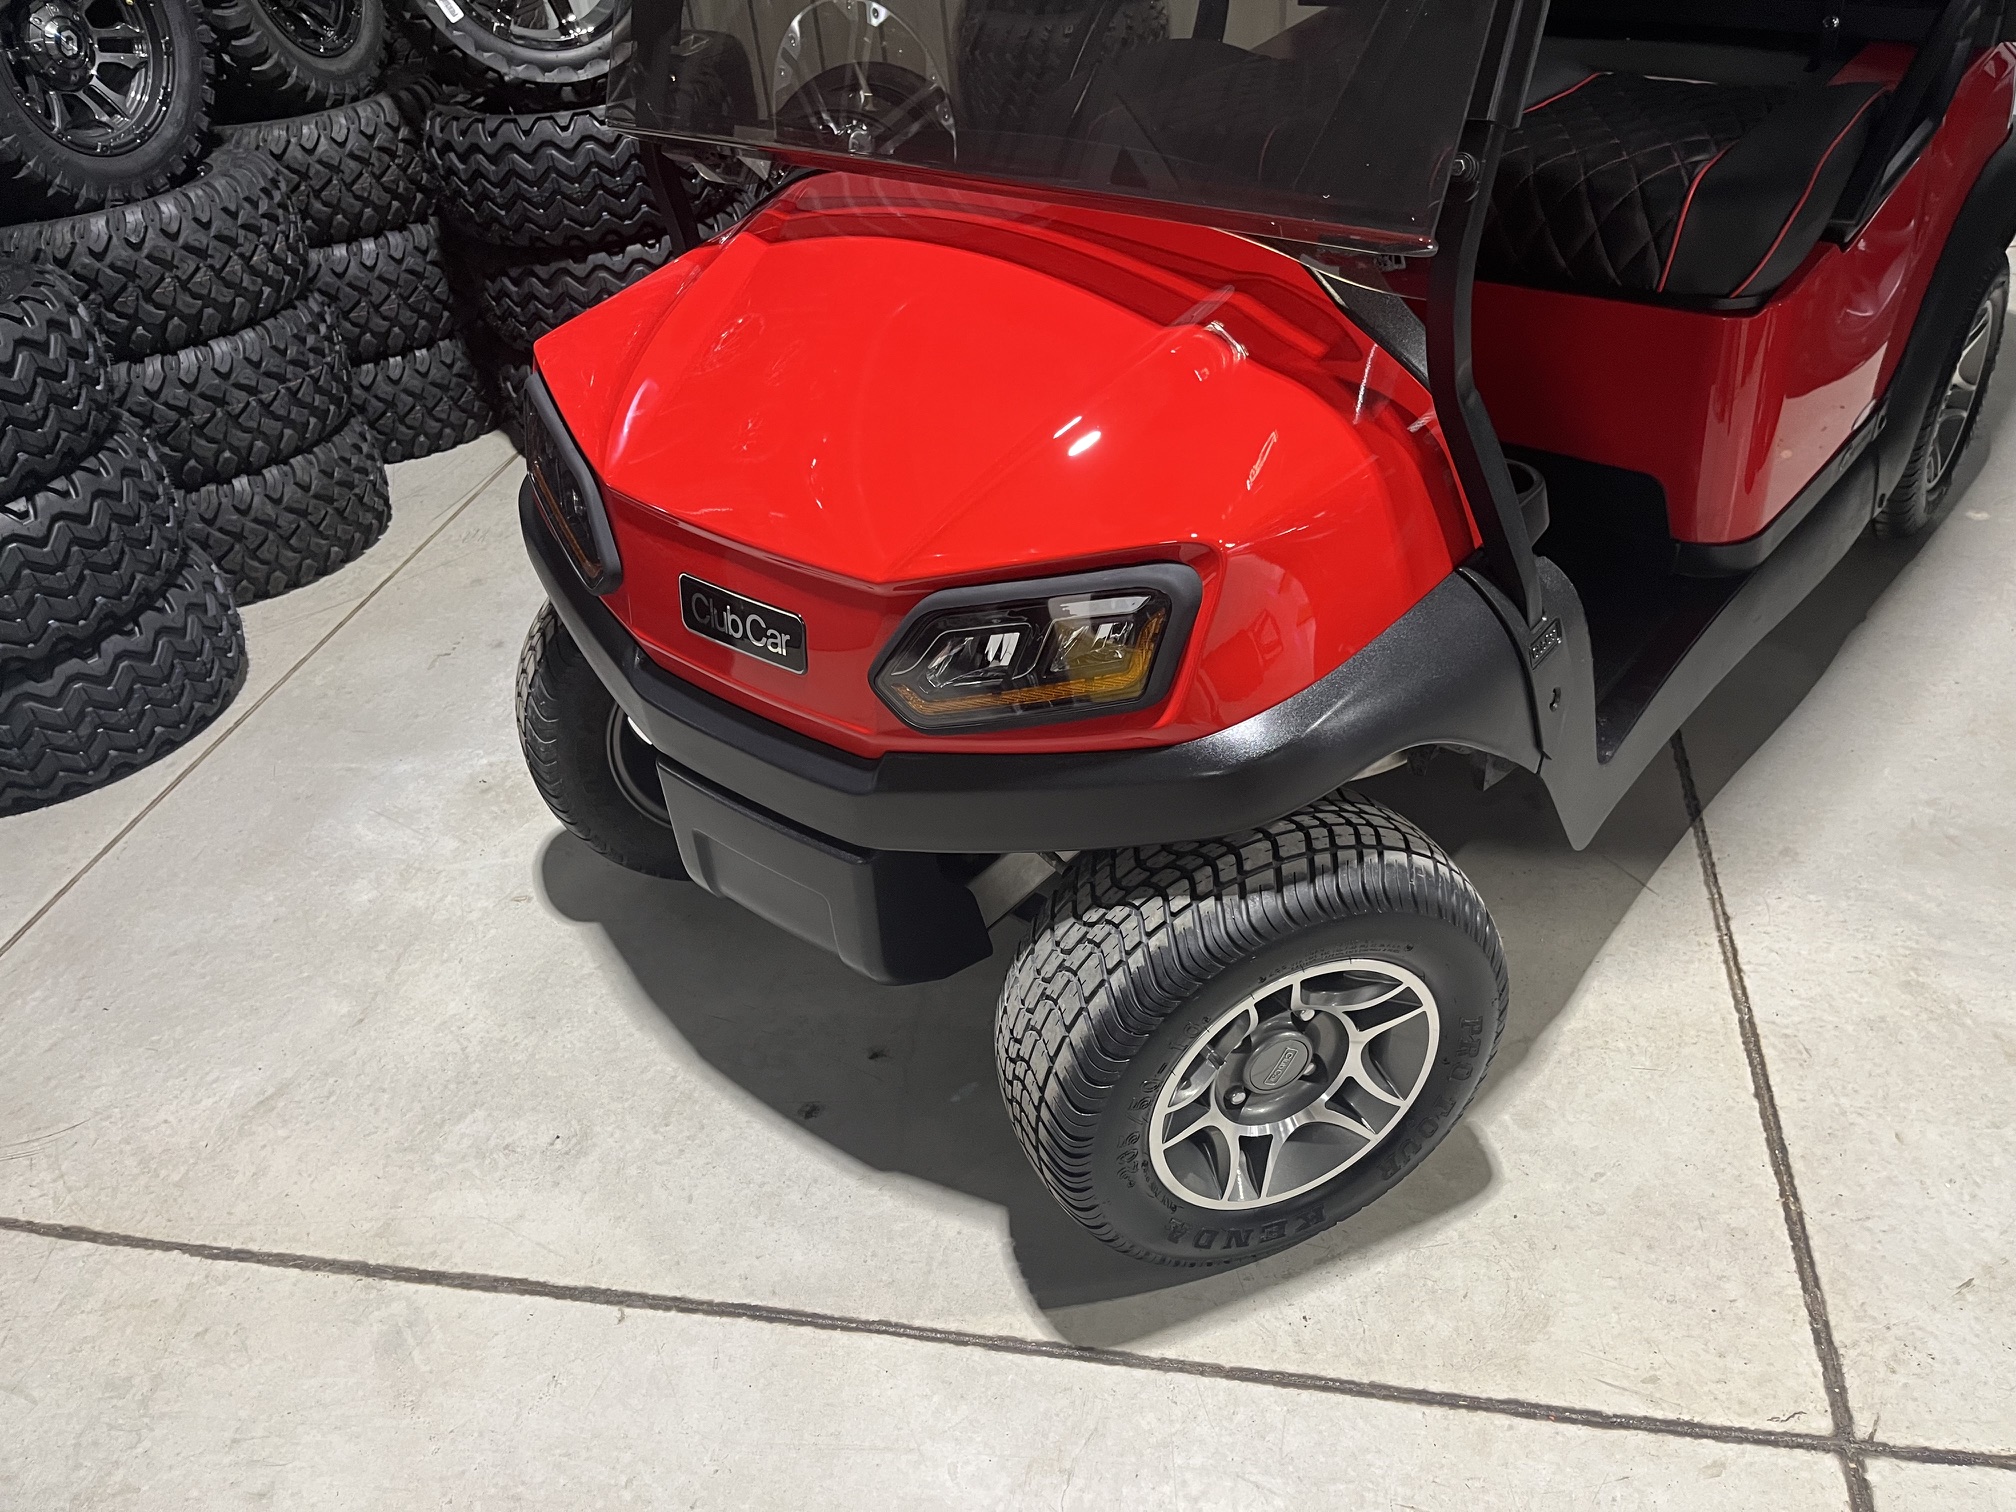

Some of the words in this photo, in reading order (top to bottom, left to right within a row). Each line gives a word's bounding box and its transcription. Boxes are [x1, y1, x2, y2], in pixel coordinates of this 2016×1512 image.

[691, 592, 743, 638] Club
[745, 613, 790, 656] Car
[1449, 1015, 1484, 1081] PRO
[1378, 1097, 1457, 1181] TOUR
[1164, 1204, 1326, 1249] KENDA
